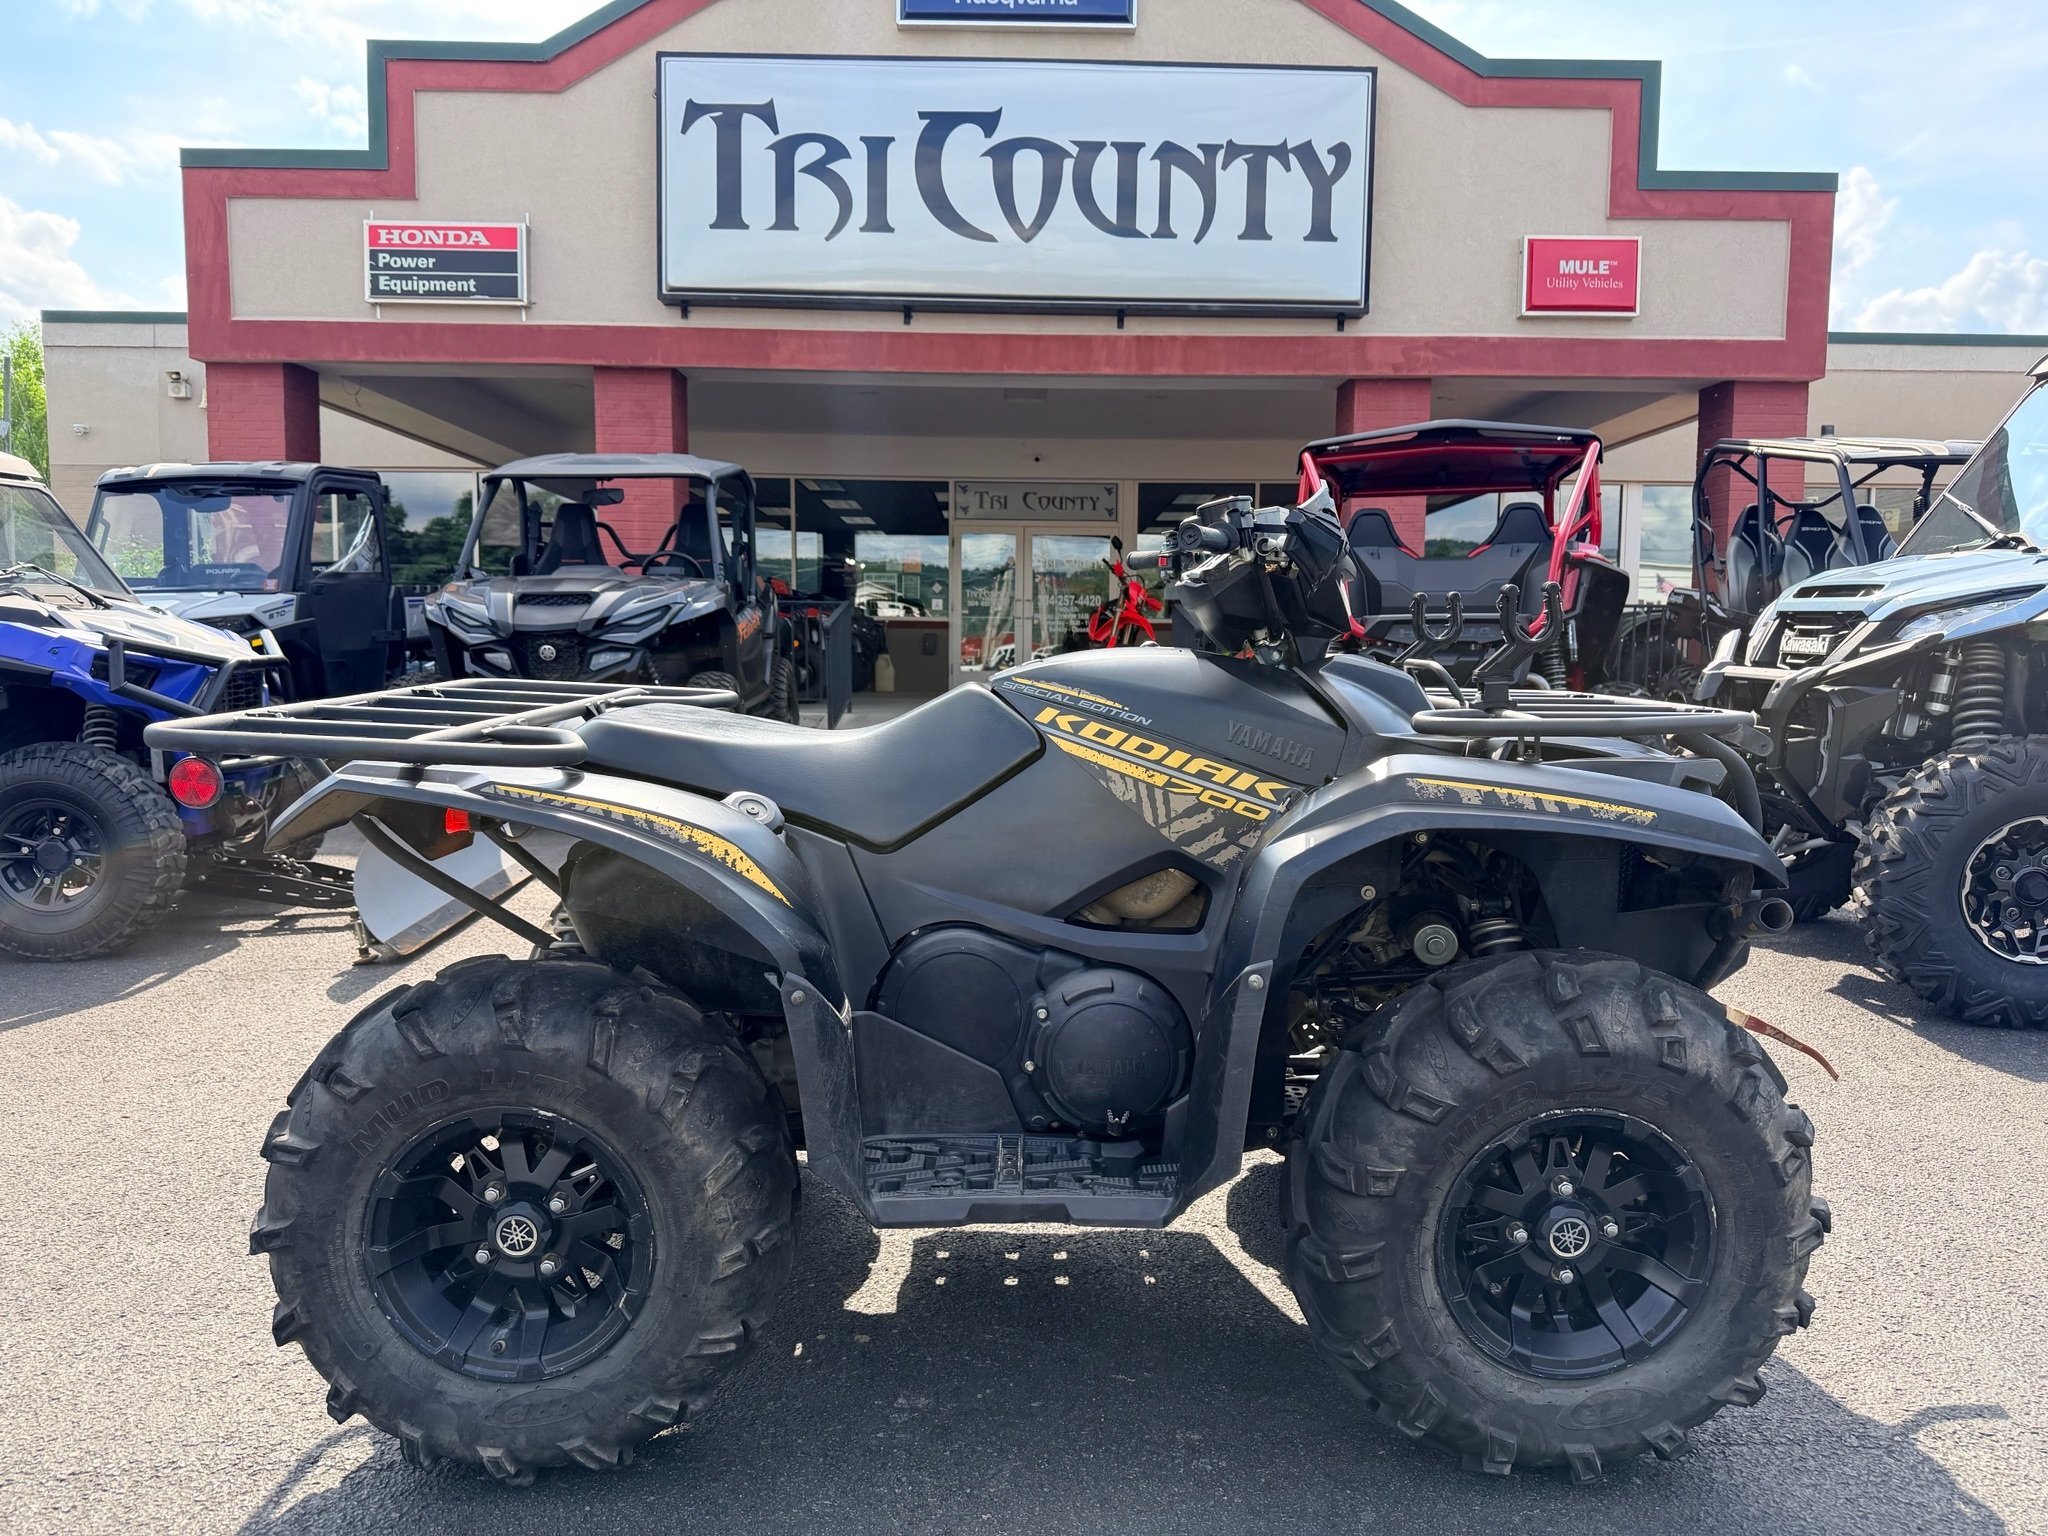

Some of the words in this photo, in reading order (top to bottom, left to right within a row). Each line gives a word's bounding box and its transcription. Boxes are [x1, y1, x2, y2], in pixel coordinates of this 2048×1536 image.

[681, 97, 896, 242] TRI
[914, 106, 1352, 244] COUNTY
[377, 229, 491, 246] HONDA
[377, 252, 437, 268] Power
[378, 276, 477, 294] Equipment
[1546, 277, 1580, 290] Utility
[1582, 277, 1624, 288] Vehicles
[974, 491, 1008, 510] TRI
[1022, 491, 1100, 511] COUNTY
[1779, 637, 1830, 654] Kawasaki
[1001, 680, 1075, 705] SPECIAL
[1081, 700, 1153, 726] EDITION
[1034, 706, 1291, 802] KODIAK
[1227, 719, 1314, 771] YAMAHA
[1164, 778, 1273, 821] 700
[351, 1078, 450, 1158] MUD
